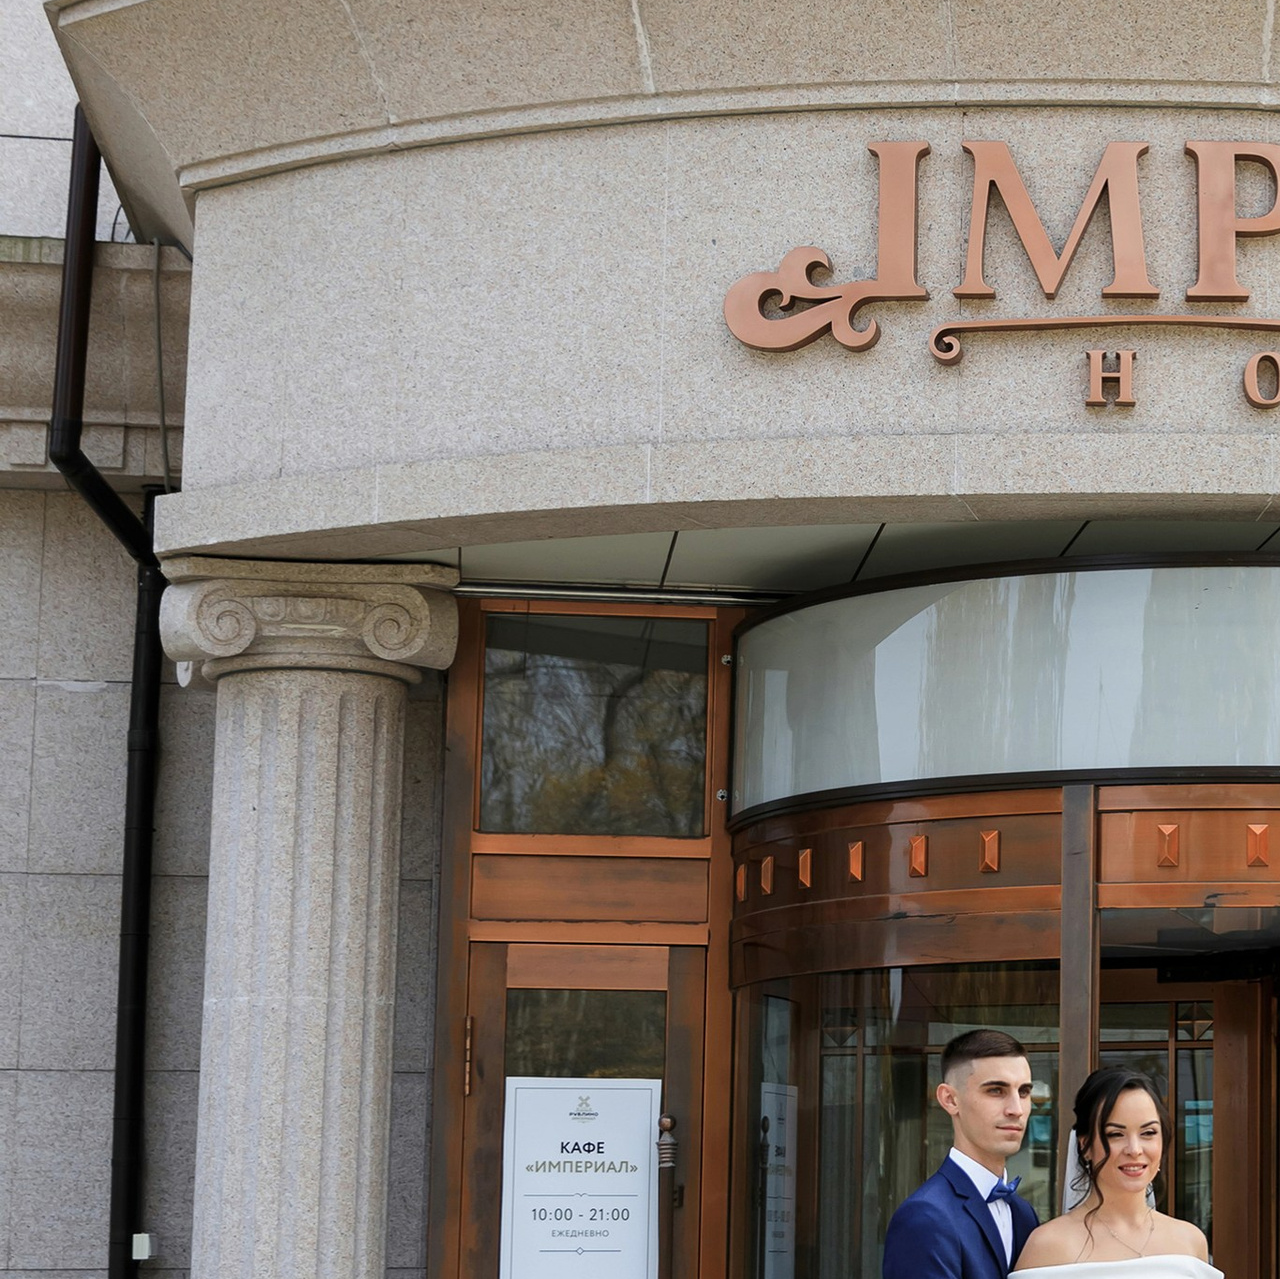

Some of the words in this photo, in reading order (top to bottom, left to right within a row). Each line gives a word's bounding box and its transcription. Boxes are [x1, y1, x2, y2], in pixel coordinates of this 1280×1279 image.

[560, 1141, 605, 1154] КАФЕ
[525, 1160, 638, 1173] «ИМПЕРИАЛ»
[531, 1208, 573, 1221] 10:00
[589, 1208, 630, 1221] 21:00
[551, 1229, 610, 1238] ЕЖЕДНЕВНО
